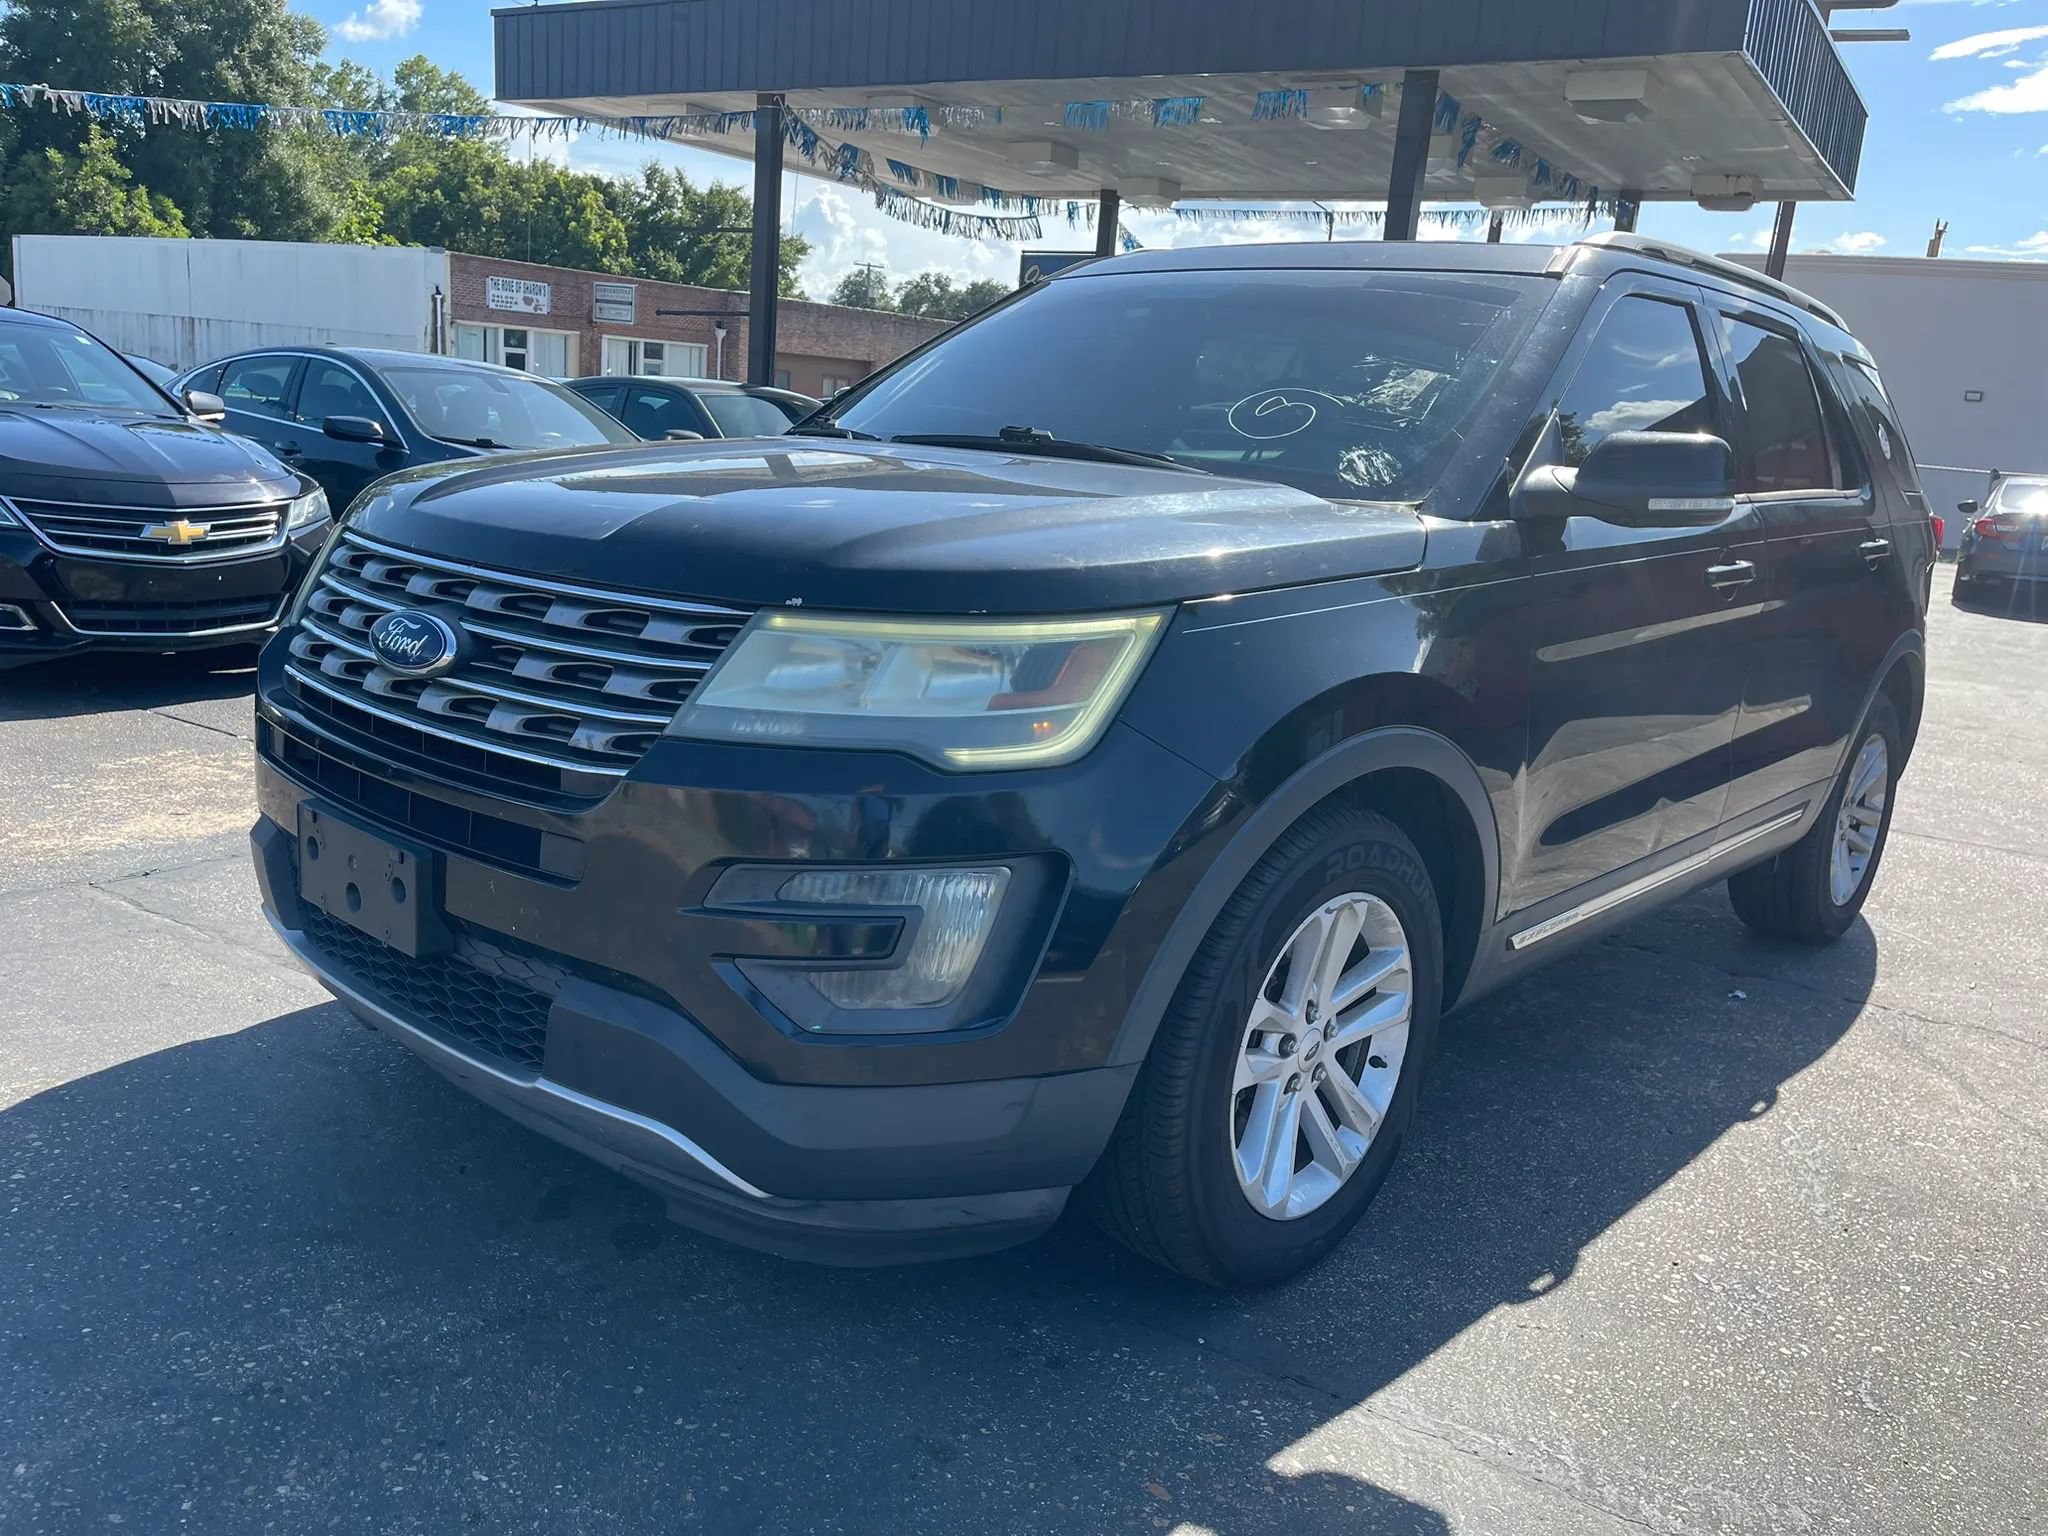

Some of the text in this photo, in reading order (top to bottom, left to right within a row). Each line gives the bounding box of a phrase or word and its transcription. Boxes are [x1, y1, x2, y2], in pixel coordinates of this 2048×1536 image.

[491, 278, 500, 291] THE
[501, 279, 514, 292] ROSE
[515, 281, 522, 293] OF
[379, 617, 429, 661] Ford
[1518, 912, 1580, 945] EXPLORER
